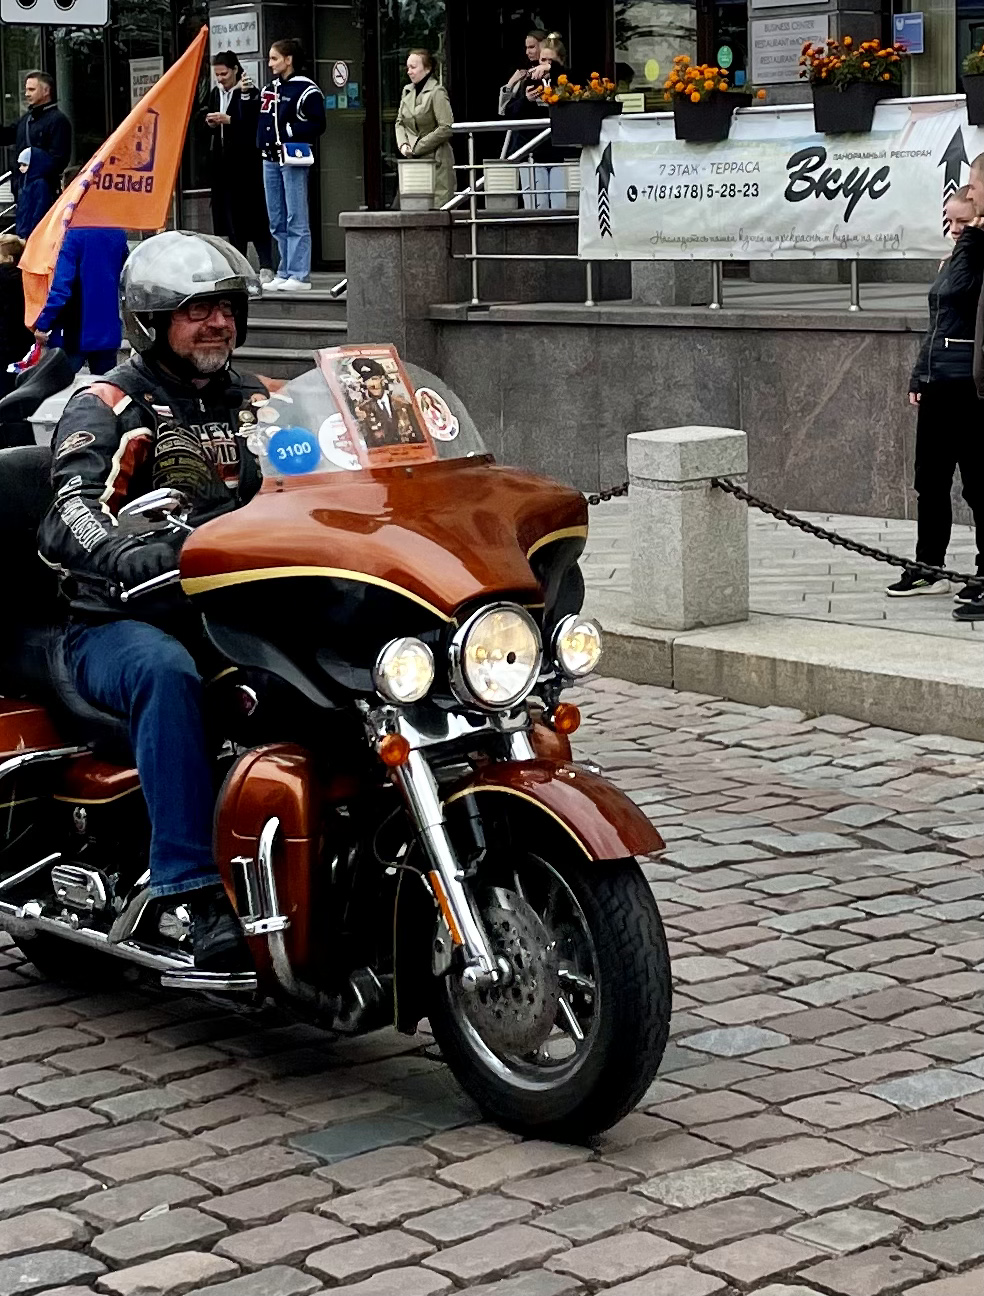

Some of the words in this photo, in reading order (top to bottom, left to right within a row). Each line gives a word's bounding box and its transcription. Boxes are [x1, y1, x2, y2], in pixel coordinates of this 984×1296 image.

[764, 22, 790, 33] BUSINESS
[832, 150, 887, 161] ПАНОРАМНЫЙ
[890, 149, 932, 159] РЕСТОРАН
[658, 164, 666, 176] 7
[668, 162, 699, 176] ЭТАЖ
[710, 161, 761, 175] ТЕРРАСА
[784, 145, 891, 223] Вкус
[641, 184, 704, 202] +7(81378)
[706, 183, 760, 199] 5-28-23
[276, 442, 312, 460] 3100
